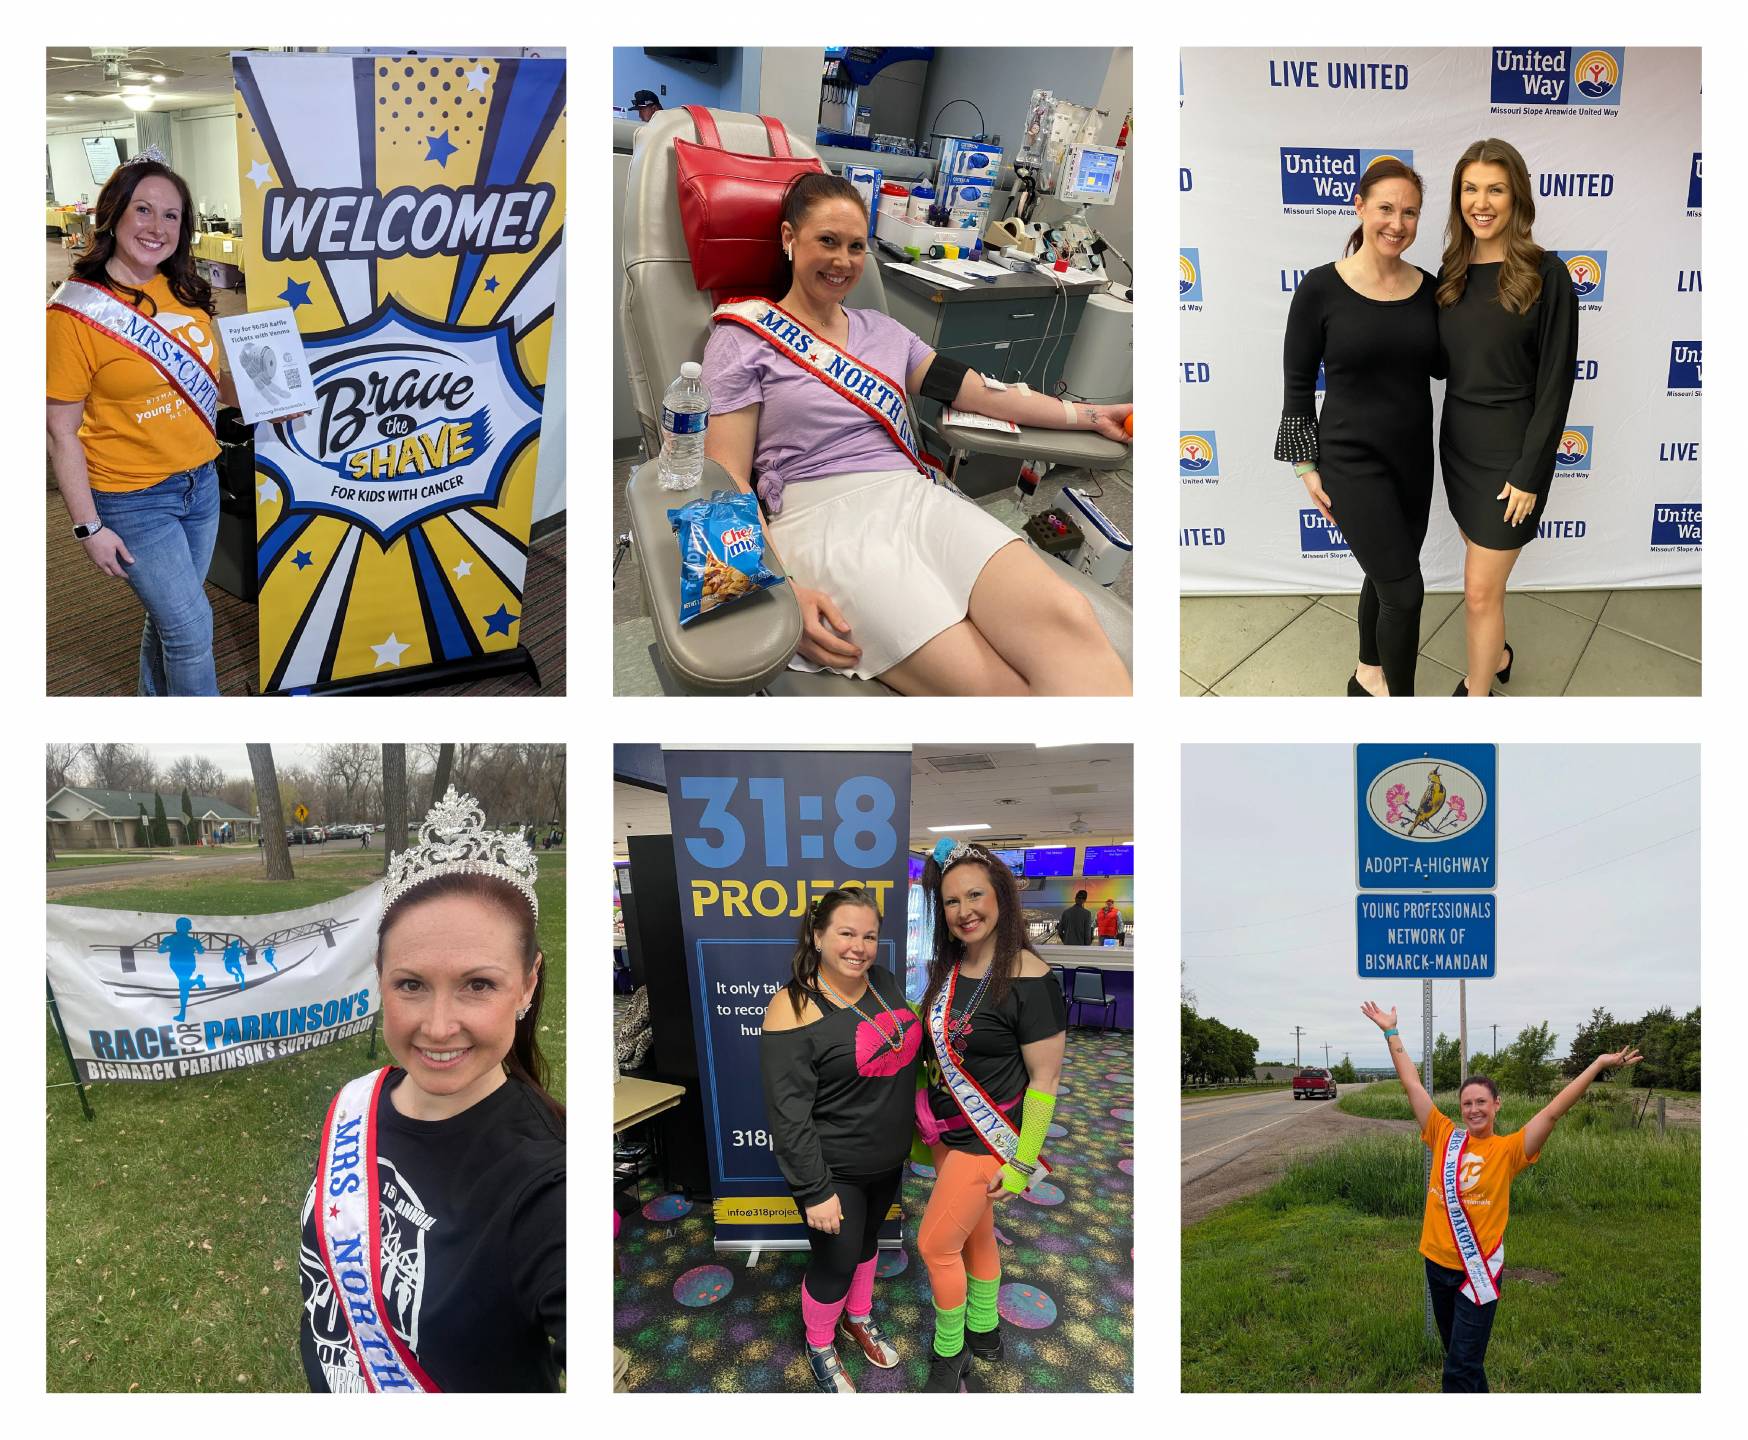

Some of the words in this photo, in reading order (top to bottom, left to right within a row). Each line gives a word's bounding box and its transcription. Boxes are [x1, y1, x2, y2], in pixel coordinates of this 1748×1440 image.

[1496, 50, 1566, 72] United
[1270, 60, 1319, 87] LIVE
[1328, 62, 1408, 90] UNITED
[1523, 74, 1564, 100] Way
[1490, 107, 1522, 115] Missouri
[1523, 108, 1543, 116] Slope
[1545, 108, 1577, 116] Areawide
[1578, 108, 1602, 116] United
[1604, 109, 1618, 118] Way
[1284, 154, 1356, 175] United
[1314, 177, 1356, 202] Way
[1540, 174, 1614, 197] UNITED
[270, 191, 548, 254] WELCOME!
[1284, 207, 1315, 216] Missouri
[1316, 208, 1337, 217] Slope
[1281, 270, 1307, 292] LI
[1188, 304, 1203, 312] Way
[1588, 304, 1602, 312] Way
[232, 335, 254, 344] Tickets
[255, 332, 268, 340] with
[270, 329, 290, 337] Venmo
[757, 309, 815, 354] MRS
[825, 354, 904, 425] NORTH
[136, 403, 172, 424] young
[315, 368, 474, 460] Brave
[385, 416, 408, 436] the
[350, 422, 474, 480] SHAVE
[1660, 442, 1699, 462] LIVE
[1206, 478, 1220, 486] Way
[1576, 472, 1589, 480] Way
[331, 486, 356, 501] FOR
[358, 490, 386, 502] KIDS
[388, 488, 418, 502] WITH
[421, 474, 464, 498] CANCER
[1678, 524, 1702, 543] Wa
[729, 538, 758, 557] mix
[680, 776, 898, 868] 31:8
[1365, 857, 1490, 873] ADOPT-A-HIGHWAY
[1362, 902, 1400, 918] YOUNG
[1404, 902, 1490, 918] PROFESSIONALS
[1388, 928, 1446, 944] NETWORK
[1450, 928, 1466, 944] OF
[1365, 954, 1488, 970] BISMARCK-MANDAN
[716, 981, 727, 994] It
[730, 981, 760, 998] only
[716, 1004, 732, 1016] to
[88, 1024, 179, 1060] RACE
[176, 1023, 204, 1055] FOR
[204, 988, 370, 1050] PARKINSON'S
[86, 1060, 176, 1081] BISMARCK
[180, 1041, 276, 1077] PARKINSON'S
[279, 1026, 335, 1056] SUPPORT
[338, 1016, 374, 1040] GROUP
[932, 1015, 968, 1095] CAPITAL
[963, 1094, 1004, 1136] CITY
[330, 1115, 362, 1197] MRS
[1444, 1161, 1459, 1204] NORTH
[394, 1198, 437, 1232] ANNUAL
[728, 1208, 801, 1218] info@318projec
[1451, 1208, 1478, 1261] DAKOTA
[332, 1234, 415, 1391] NORTH
